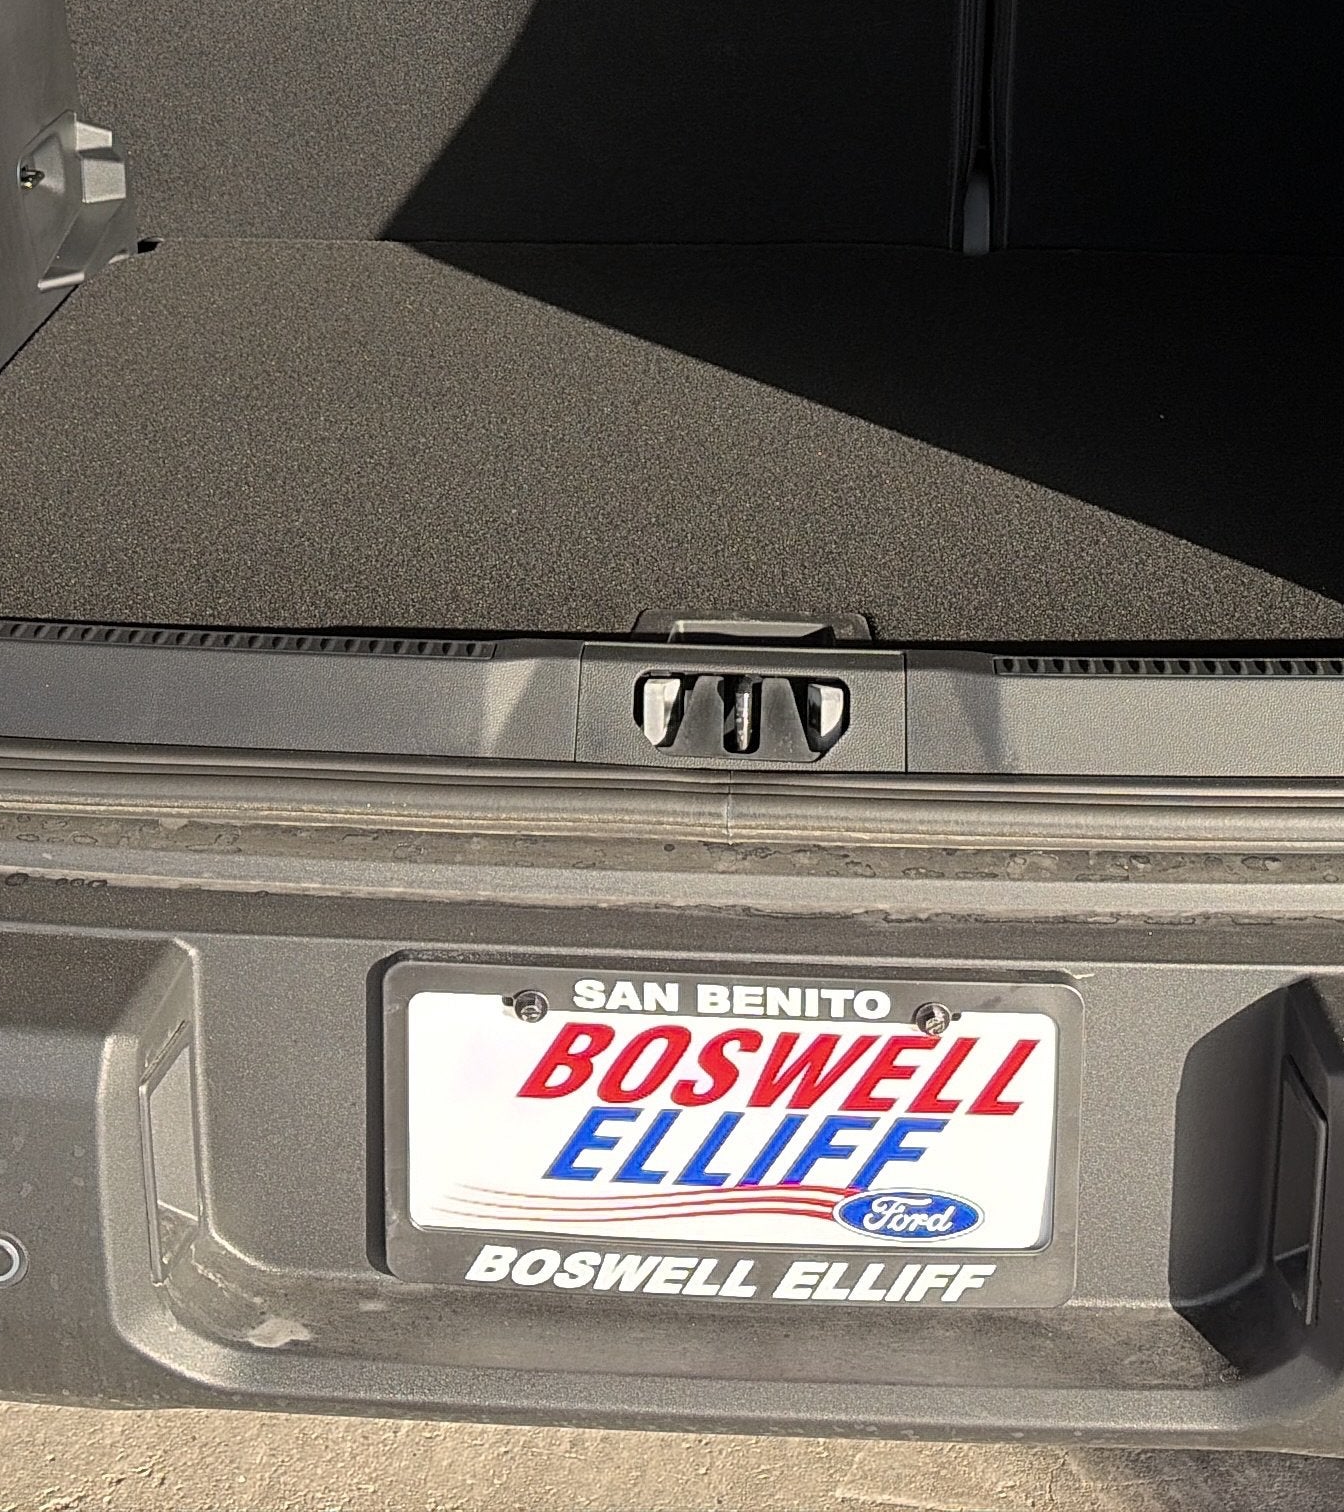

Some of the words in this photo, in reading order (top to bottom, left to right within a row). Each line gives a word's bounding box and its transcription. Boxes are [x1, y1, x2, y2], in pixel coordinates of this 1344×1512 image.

[573, 979, 681, 1013] SAN
[696, 984, 891, 1019] BENITO
[515, 1022, 1040, 1115] BOSWELL
[541, 1106, 951, 1190] ELLIFF
[862, 1196, 955, 1233] Ford
[464, 1244, 757, 1298] BOSWELL
[771, 1260, 997, 1303] ELLIFF
